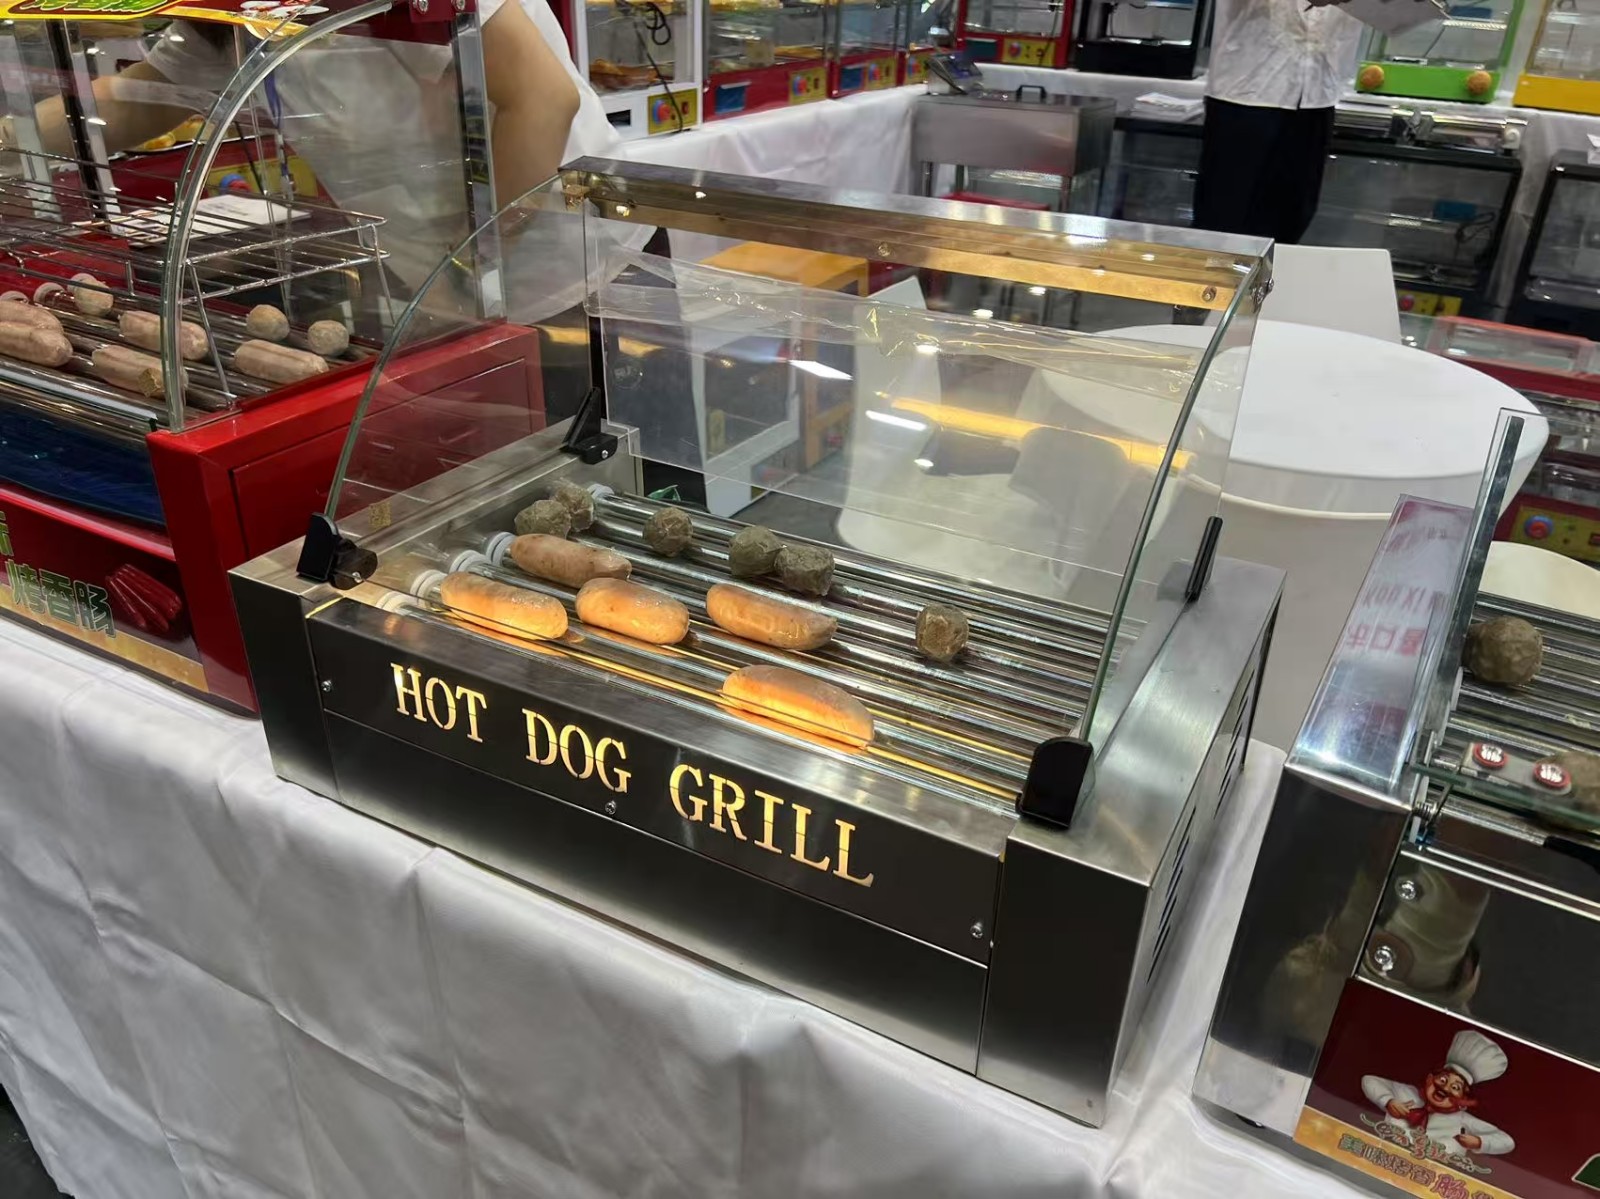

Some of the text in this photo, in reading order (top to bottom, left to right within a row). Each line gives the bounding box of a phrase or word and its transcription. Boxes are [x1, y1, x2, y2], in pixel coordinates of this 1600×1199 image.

[5, 558, 116, 638] 烤香肠
[390, 663, 875, 888] HOT DOG GRILL
[1338, 1132, 1497, 1199] 美味烤香肠
